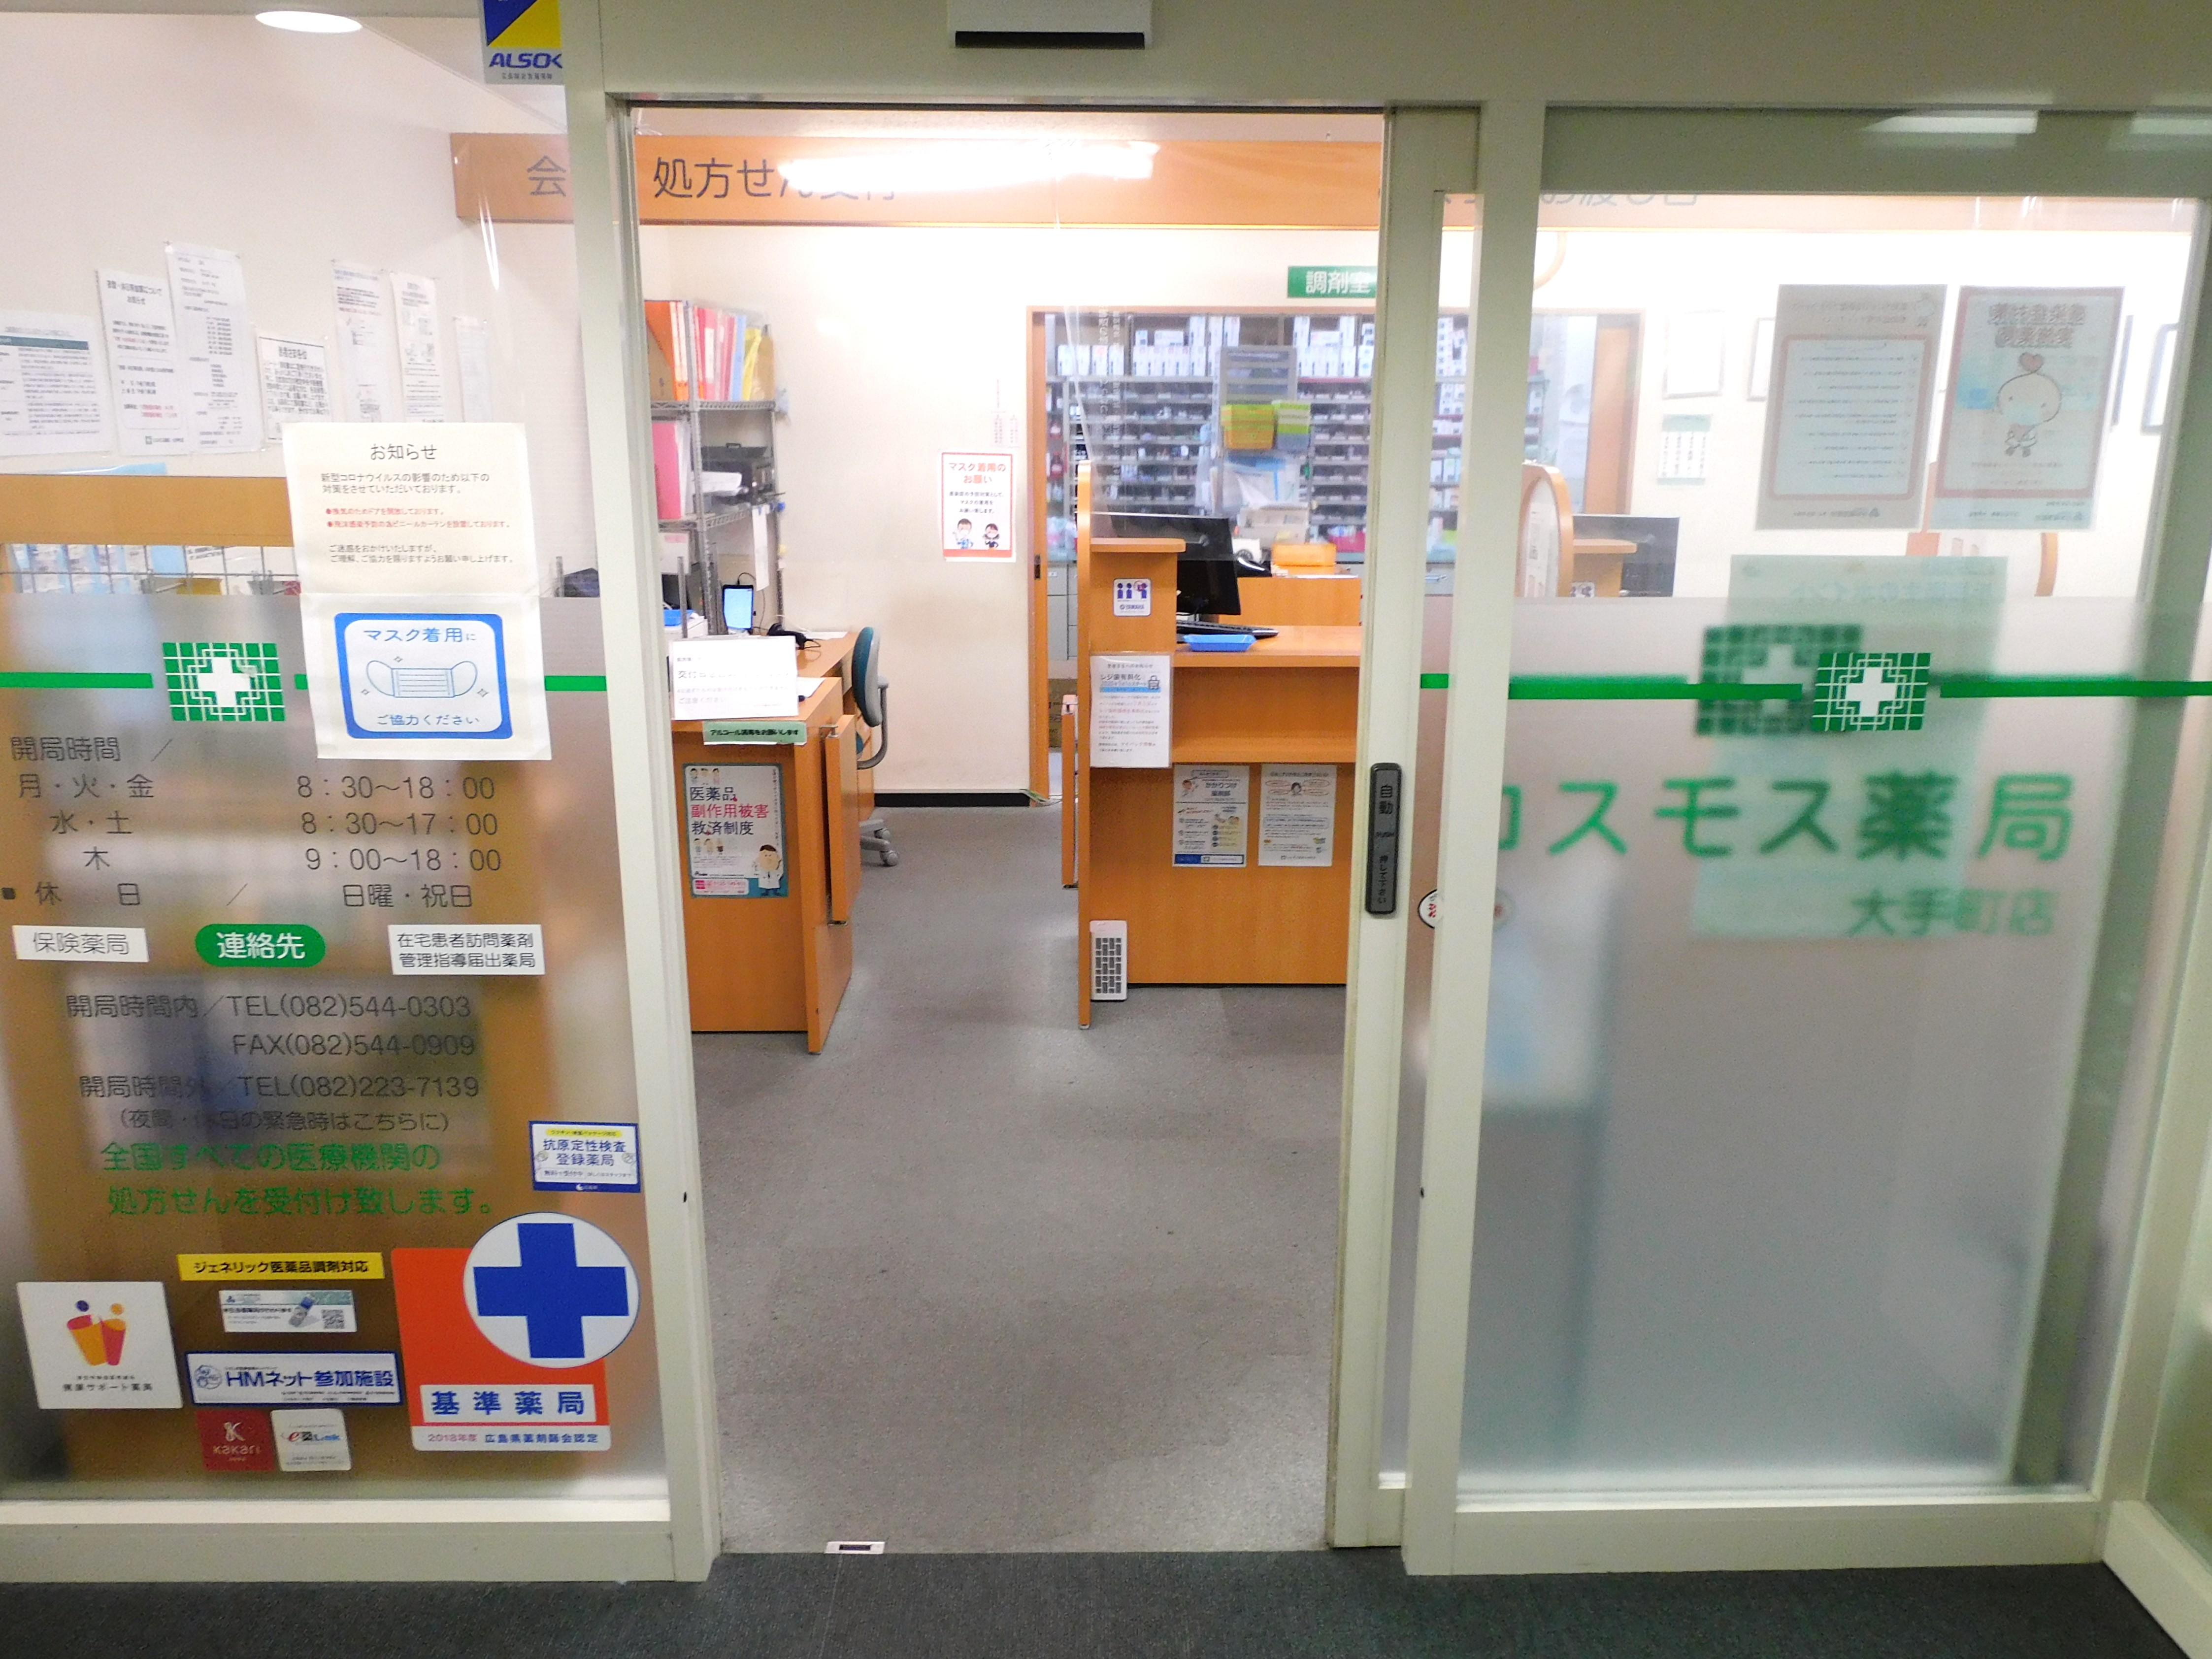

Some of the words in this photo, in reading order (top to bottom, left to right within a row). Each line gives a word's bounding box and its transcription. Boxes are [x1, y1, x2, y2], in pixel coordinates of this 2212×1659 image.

[489, 53, 562, 68] ALSOK
[1306, 270, 1372, 295] 調剤室
[370, 443, 437, 460] お知らせ
[949, 463, 1006, 472] マスク着用の
[321, 473, 490, 482] 新型コロナウイルスの影響のため以下の
[963, 474, 992, 484] お願い
[323, 485, 461, 494] 対策をさせていただいております。
[363, 628, 476, 643] マスク着用に
[377, 714, 480, 726] ご協力ください
[10, 736, 121, 762] 開局時間
[19, 773, 154, 799] 月・火・金
[690, 787, 736, 801] 医薬品
[691, 803, 769, 819] 副作用被害
[49, 810, 133, 835] 水・土
[692, 820, 755, 835] 救済制度
[83, 845, 111, 870] 木
[343, 884, 472, 908] 日曜・祝日
[33, 932, 130, 955] 保険薬局
[217, 932, 306, 960] 連絡先
[397, 932, 534, 949] 在宅患者訪問薬剤
[399, 952, 536, 969] 管理指導届出薬局
[543, 1138, 627, 1153] 抗原定性検査
[100, 1142, 440, 1172] 全国すべての医療機関の
[557, 1153, 614, 1166] 登録薬局
[108, 1186, 493, 1216] 処方せんを受付け致します。
[194, 1261, 369, 1274] ジェネリック医薬品調剤対応
[431, 1391, 585, 1416] 基準薬局
